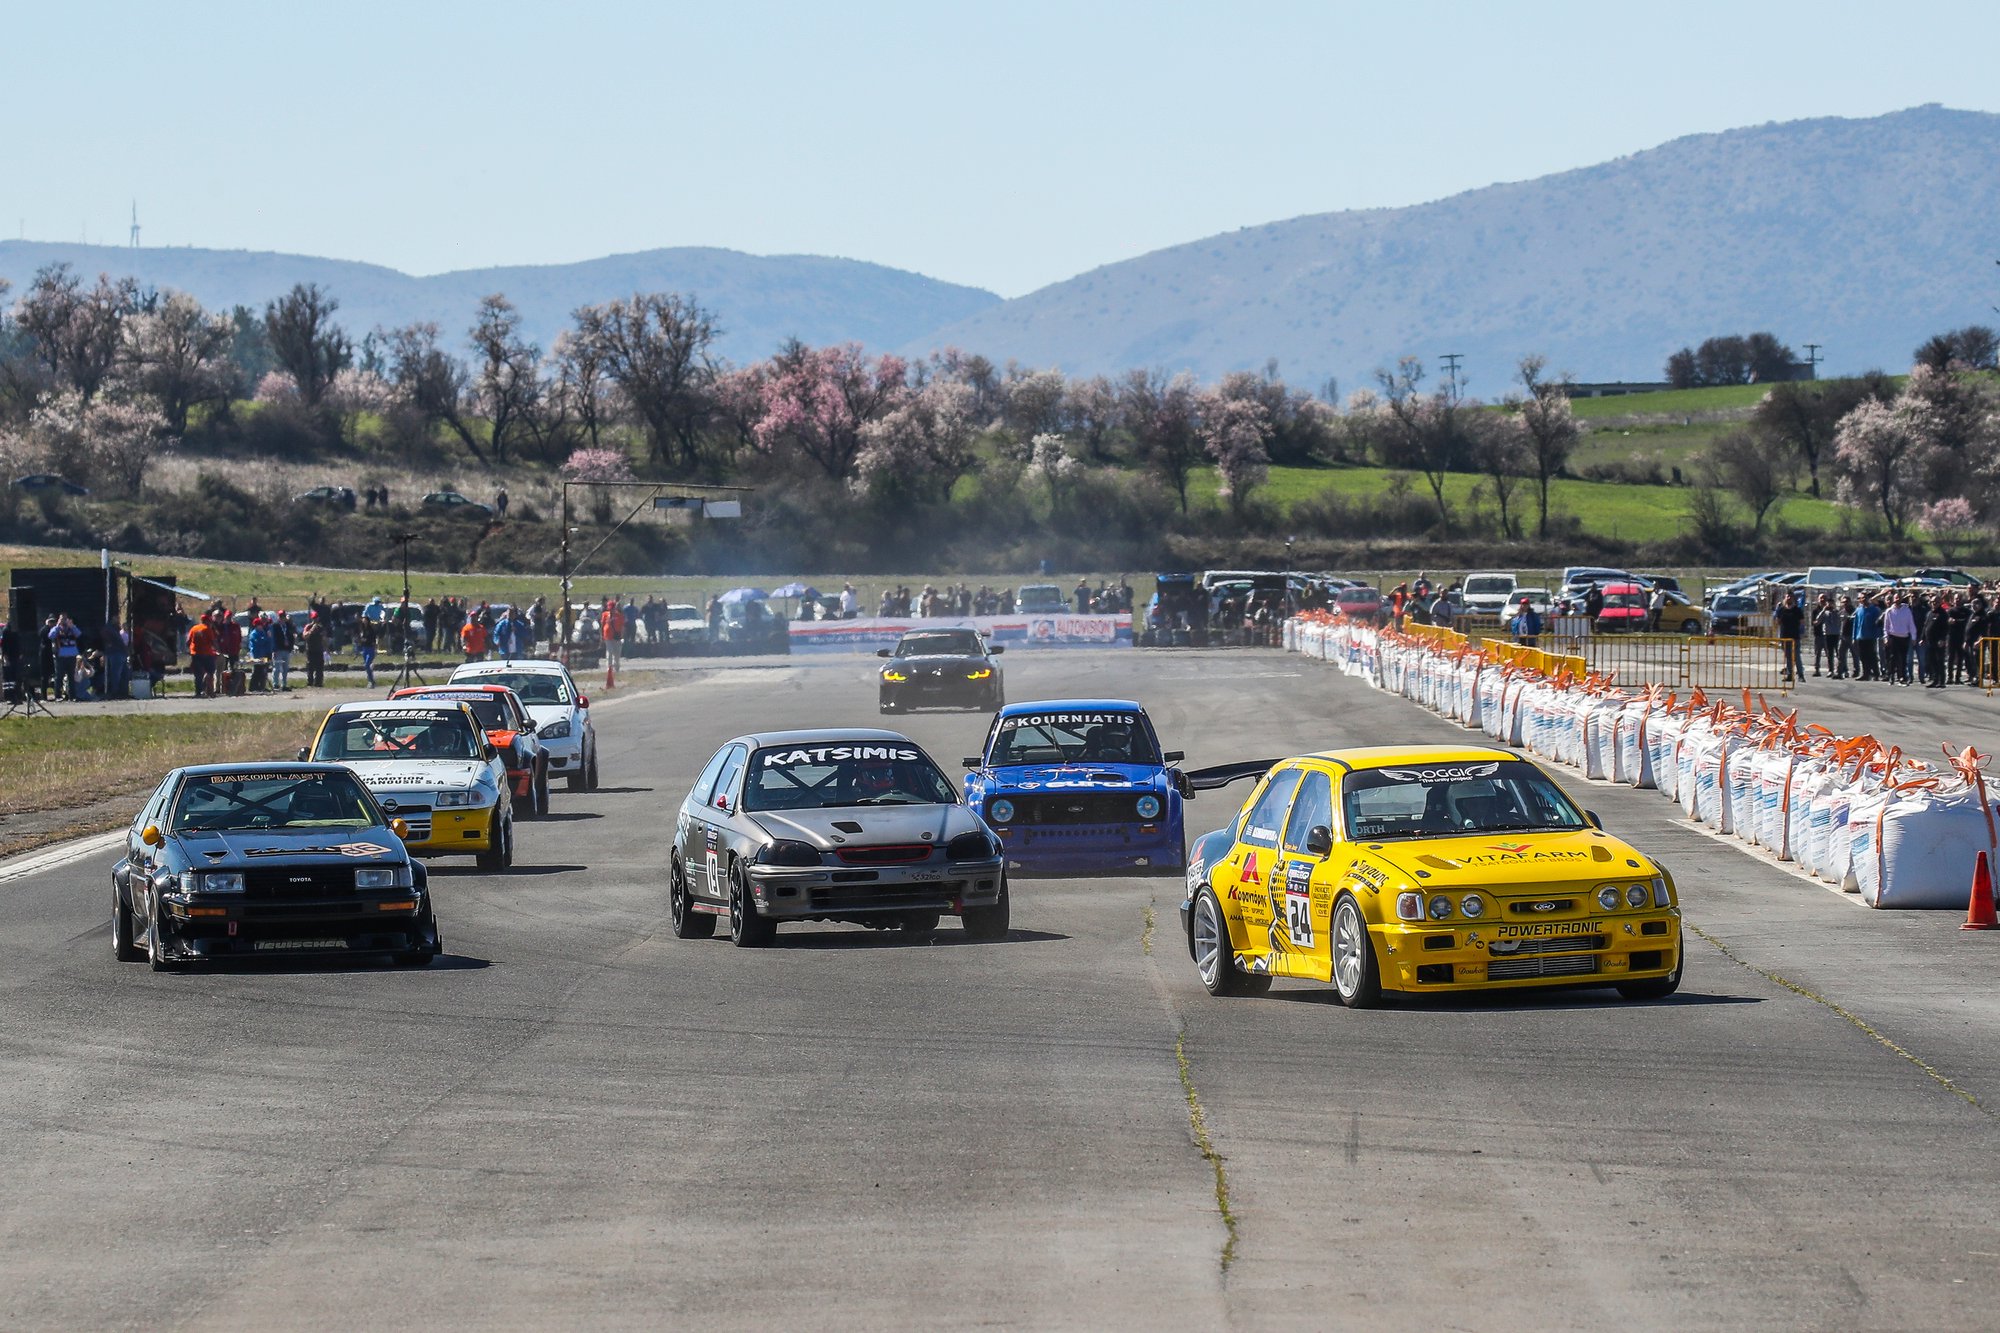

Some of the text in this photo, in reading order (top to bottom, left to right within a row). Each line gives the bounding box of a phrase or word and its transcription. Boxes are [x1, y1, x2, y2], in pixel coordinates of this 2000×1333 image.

[360, 710, 438, 719] TSAGARAS
[1017, 714, 1135, 727] KOURNIATIS
[763, 747, 918, 766] KATSIMIS
[1456, 851, 1588, 864] VITAFARM
[1473, 859, 1545, 867] TSATSOULIS
[1290, 899, 1311, 943] 24
[1498, 921, 1603, 938] POWERTRONIC
